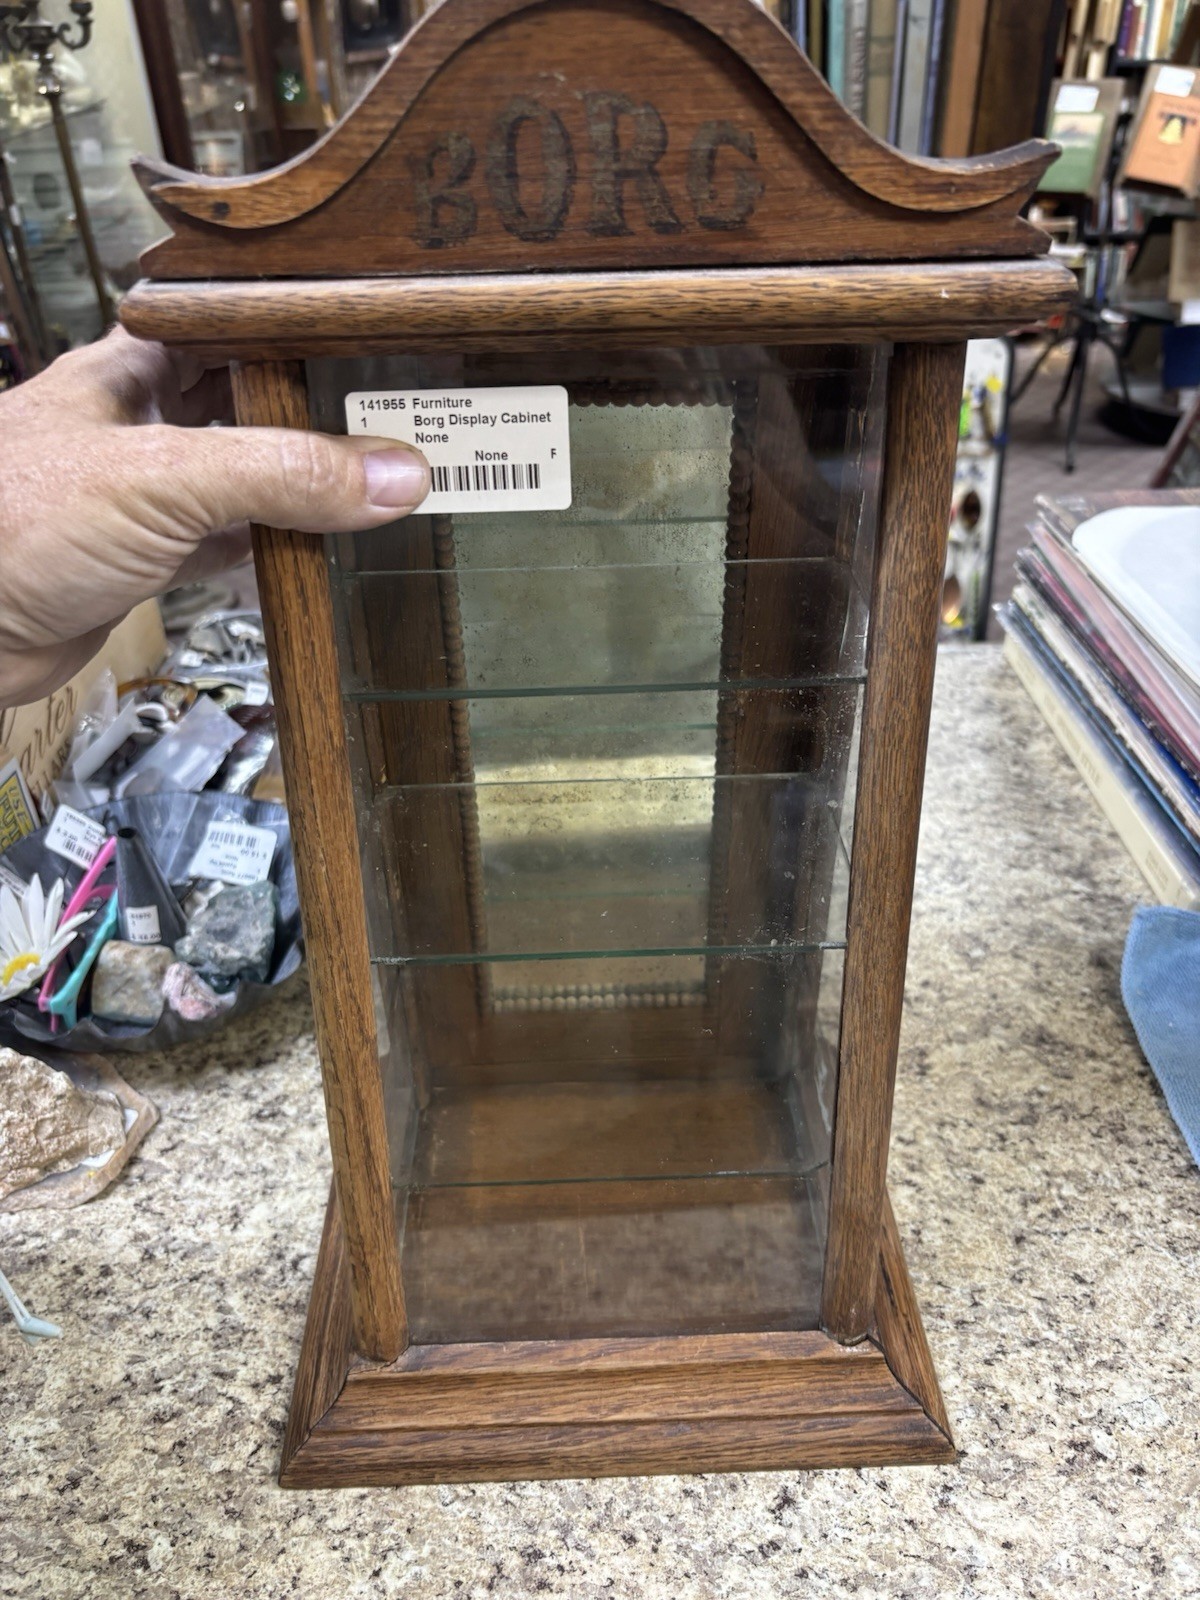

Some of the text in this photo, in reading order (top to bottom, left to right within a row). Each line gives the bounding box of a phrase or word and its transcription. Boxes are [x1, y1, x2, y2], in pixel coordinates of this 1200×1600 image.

[409, 90, 766, 249] BORG
[360, 397, 473, 411] 141955 Furniture
[361, 417, 367, 428] 1
[414, 411, 551, 429] Borg Display Cabinet
[415, 432, 449, 443] None
[475, 450, 508, 461] None
[550, 448, 557, 459] F
[20, 685, 78, 780] arter
